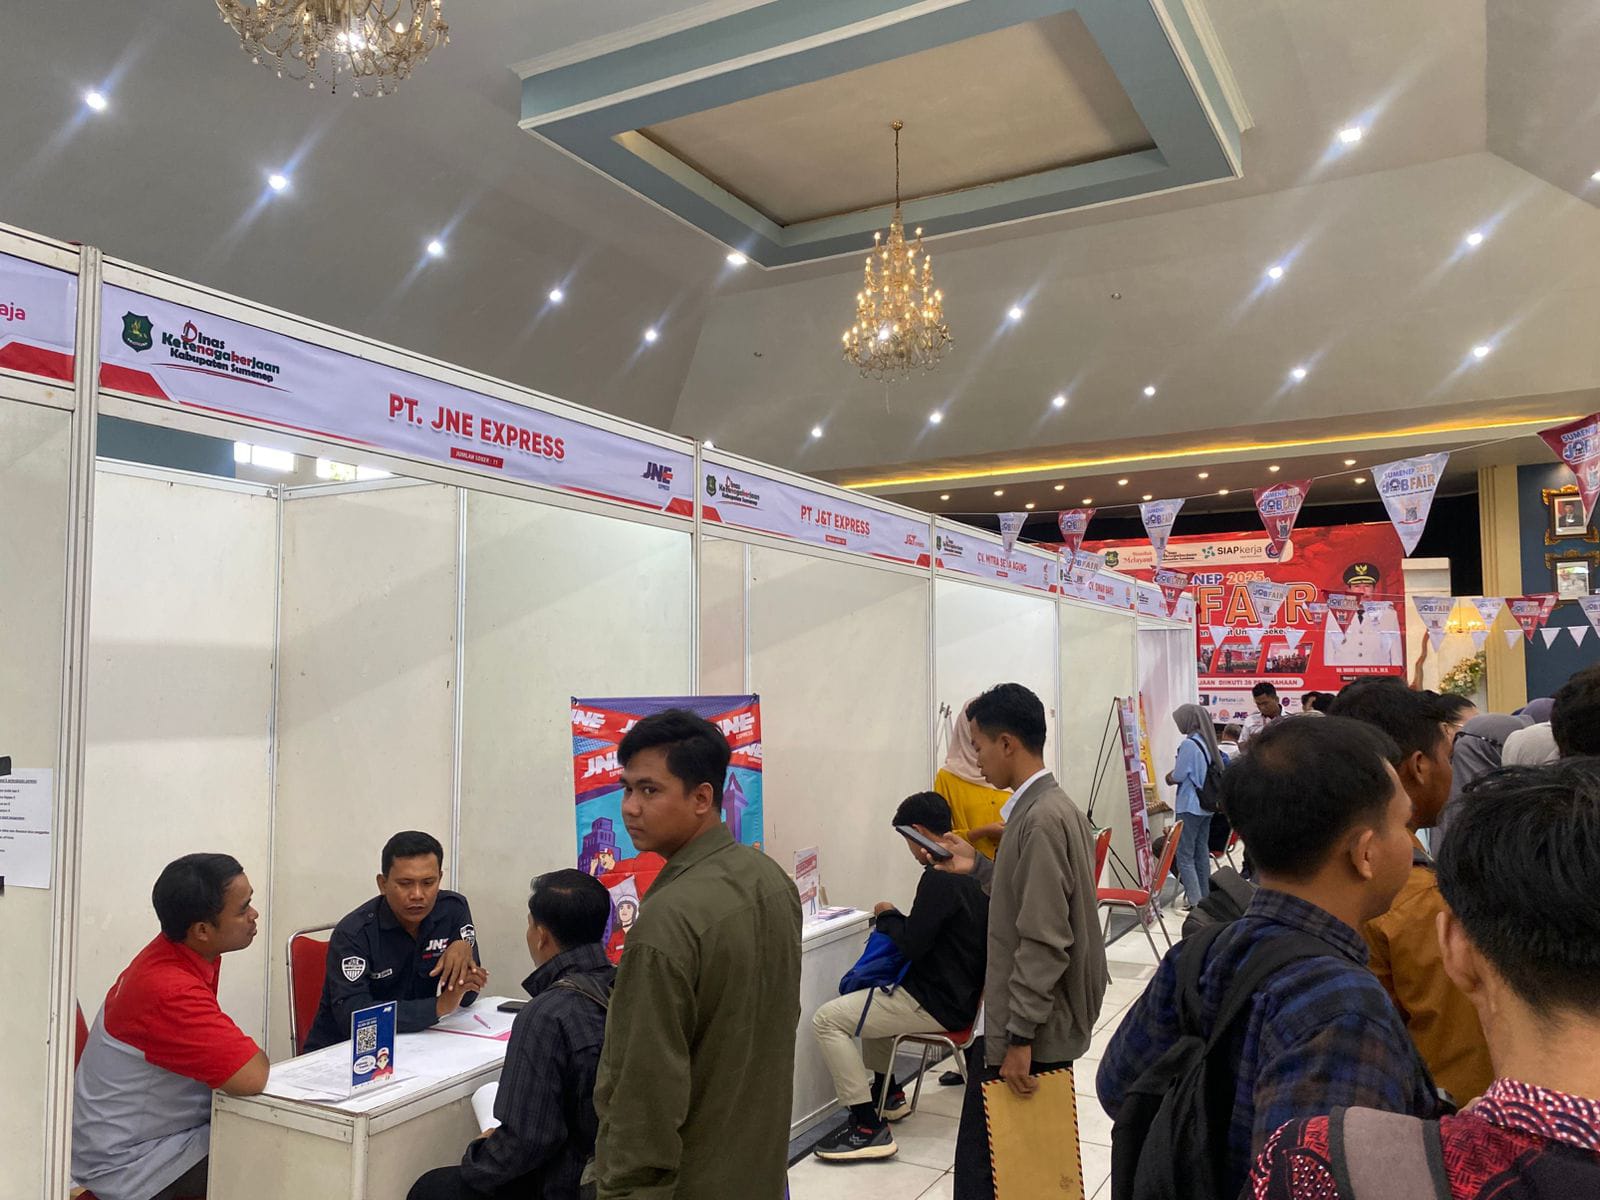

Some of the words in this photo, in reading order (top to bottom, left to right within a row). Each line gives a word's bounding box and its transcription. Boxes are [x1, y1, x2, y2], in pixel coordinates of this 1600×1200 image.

[181, 320, 225, 350] Dinas
[162, 332, 280, 374] Ketenagakerjaan
[170, 348, 228, 371] Kabupaten
[231, 364, 273, 382] Sumenep
[389, 392, 423, 425] PT.
[431, 406, 473, 437] JNE
[480, 417, 566, 460] EXPRESS
[641, 461, 673, 484] JNE
[801, 505, 812, 521] PT
[815, 509, 832, 526] J&T
[834, 513, 870, 535] EXPRESS
[1227, 571, 1264, 585] 2025
[1199, 583, 1317, 625] FAR
